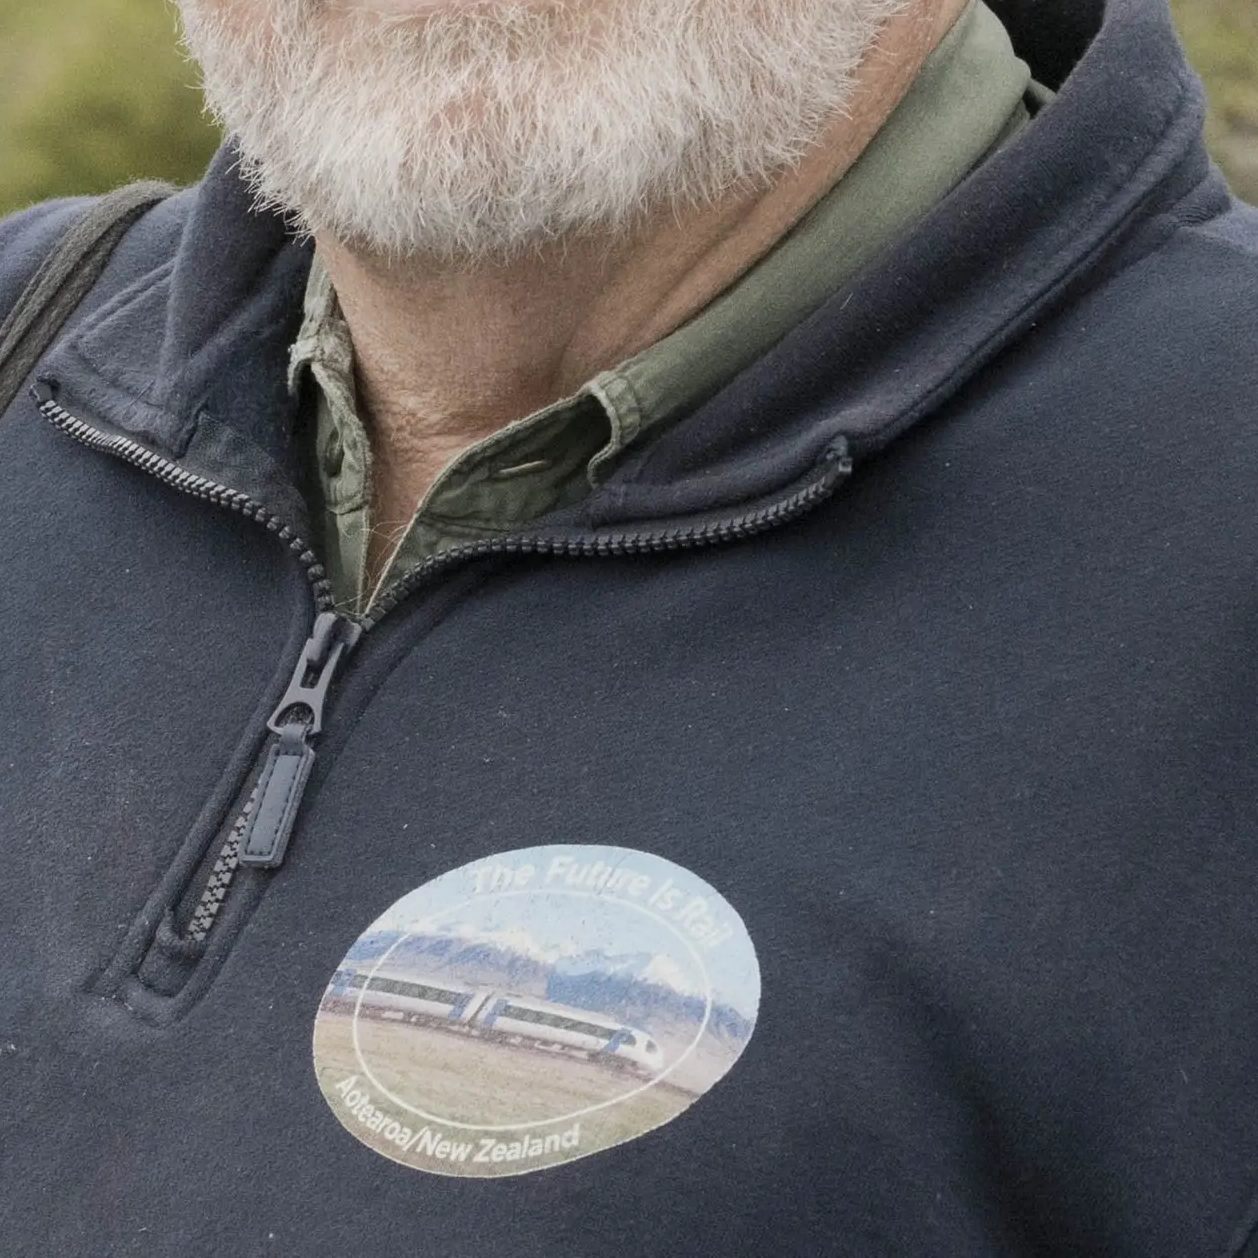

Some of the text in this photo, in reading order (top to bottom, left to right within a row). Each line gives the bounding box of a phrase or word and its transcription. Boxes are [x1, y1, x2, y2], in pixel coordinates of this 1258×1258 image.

[473, 855, 734, 948] The Future Is Rail
[336, 1074, 582, 1163] Aotearoa/New Zealand
